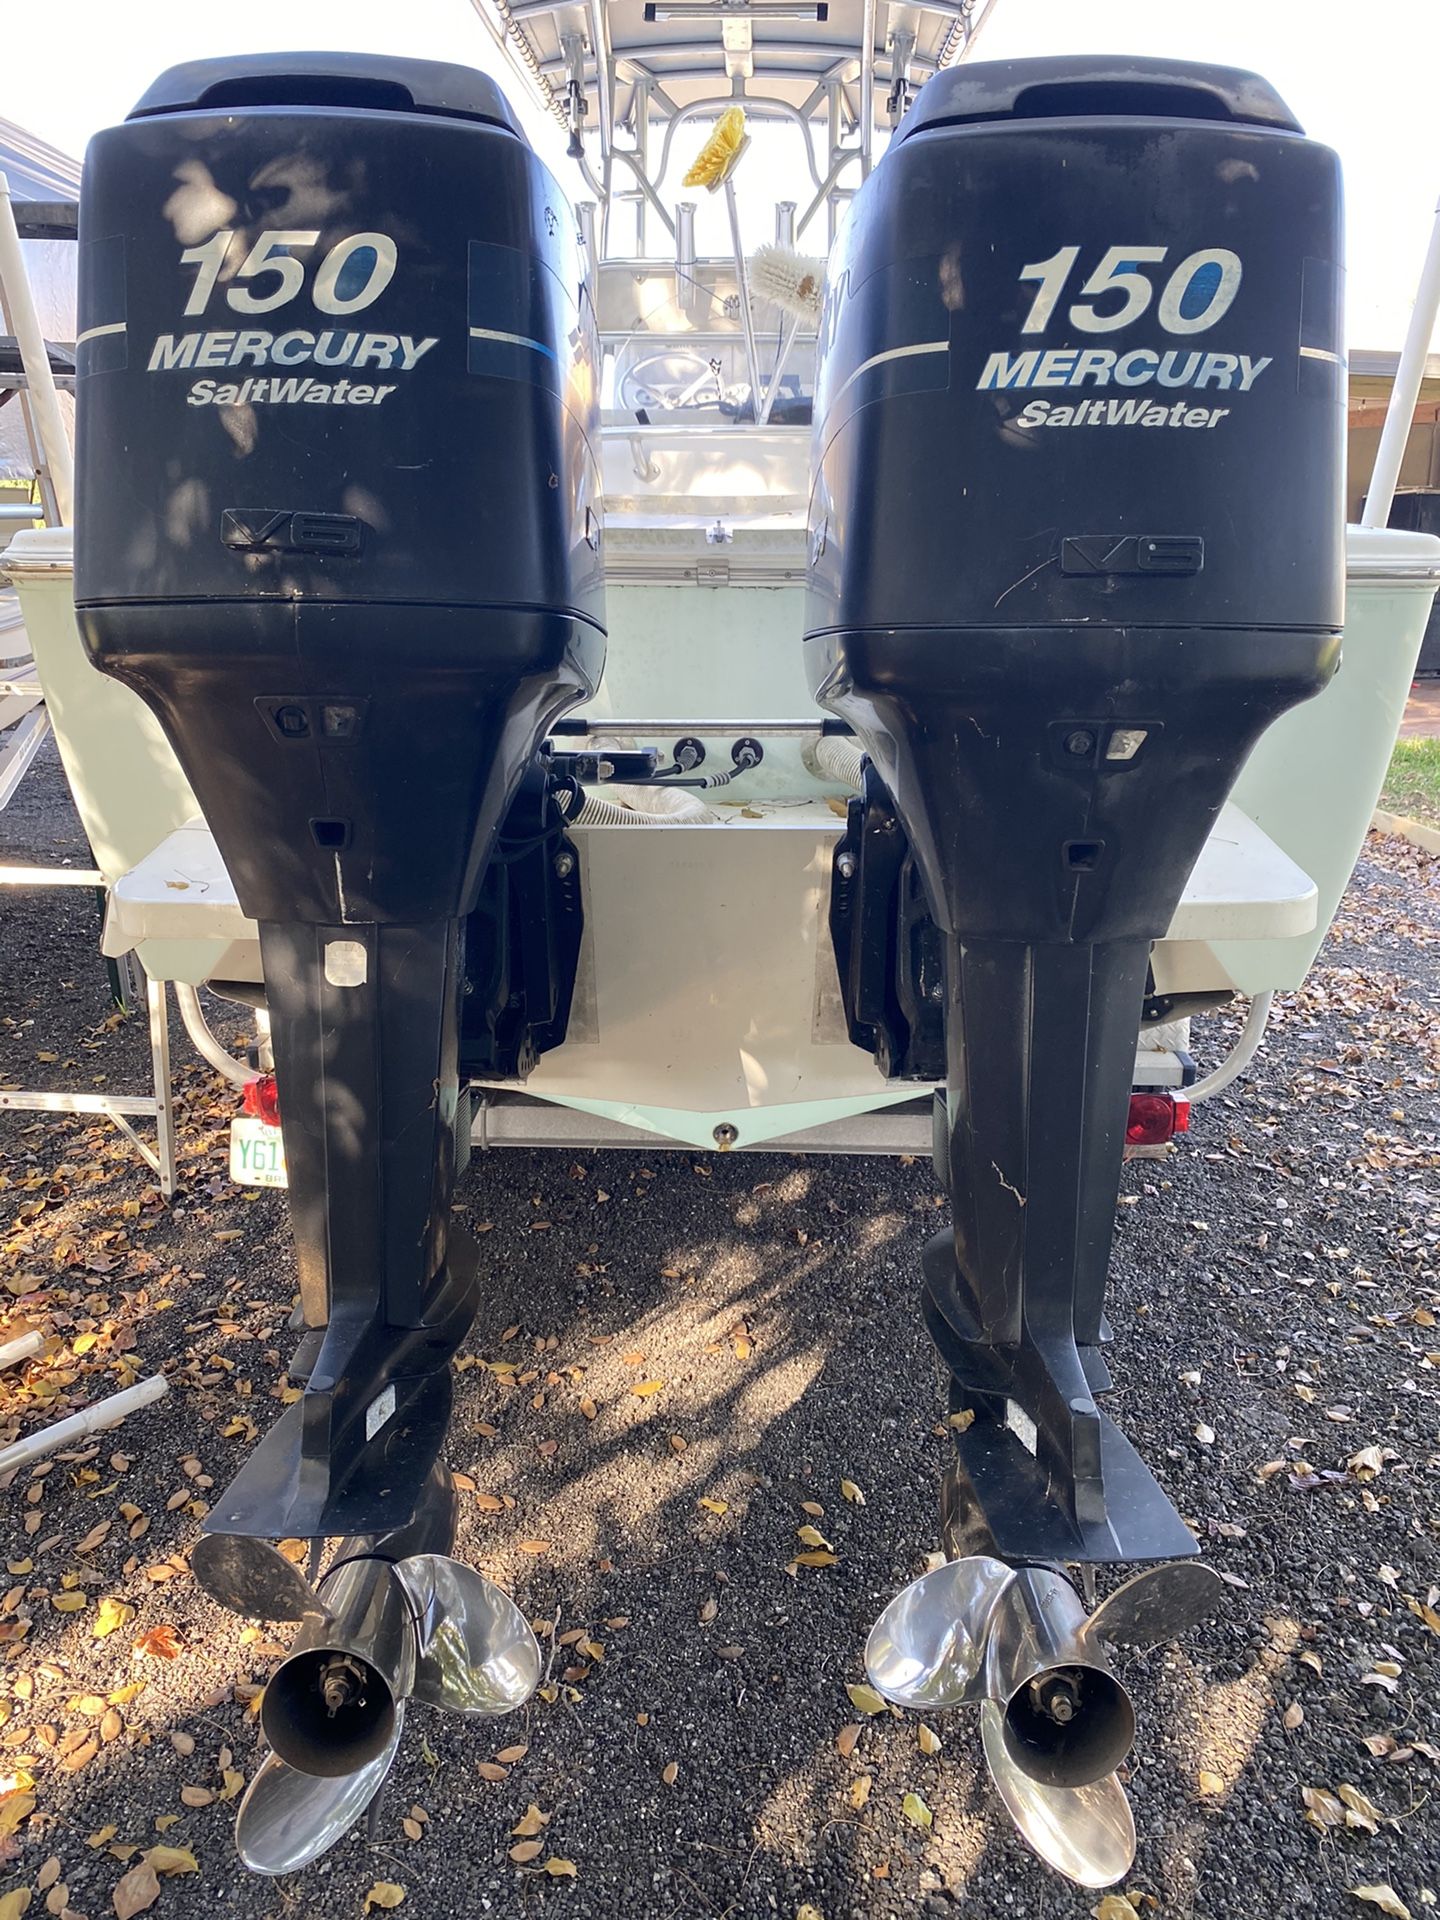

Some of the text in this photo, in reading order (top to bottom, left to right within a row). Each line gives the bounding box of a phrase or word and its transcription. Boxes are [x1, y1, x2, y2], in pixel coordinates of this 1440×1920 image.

[180, 230, 398, 316] 150
[1018, 246, 1243, 335] 150
[147, 329, 439, 372] MERCURY
[975, 348, 1273, 391] MERCURY
[187, 376, 397, 405] SaltWater
[1017, 399, 1230, 428] SaltWater
[223, 508, 360, 549] V6
[1064, 535, 1204, 572] V6
